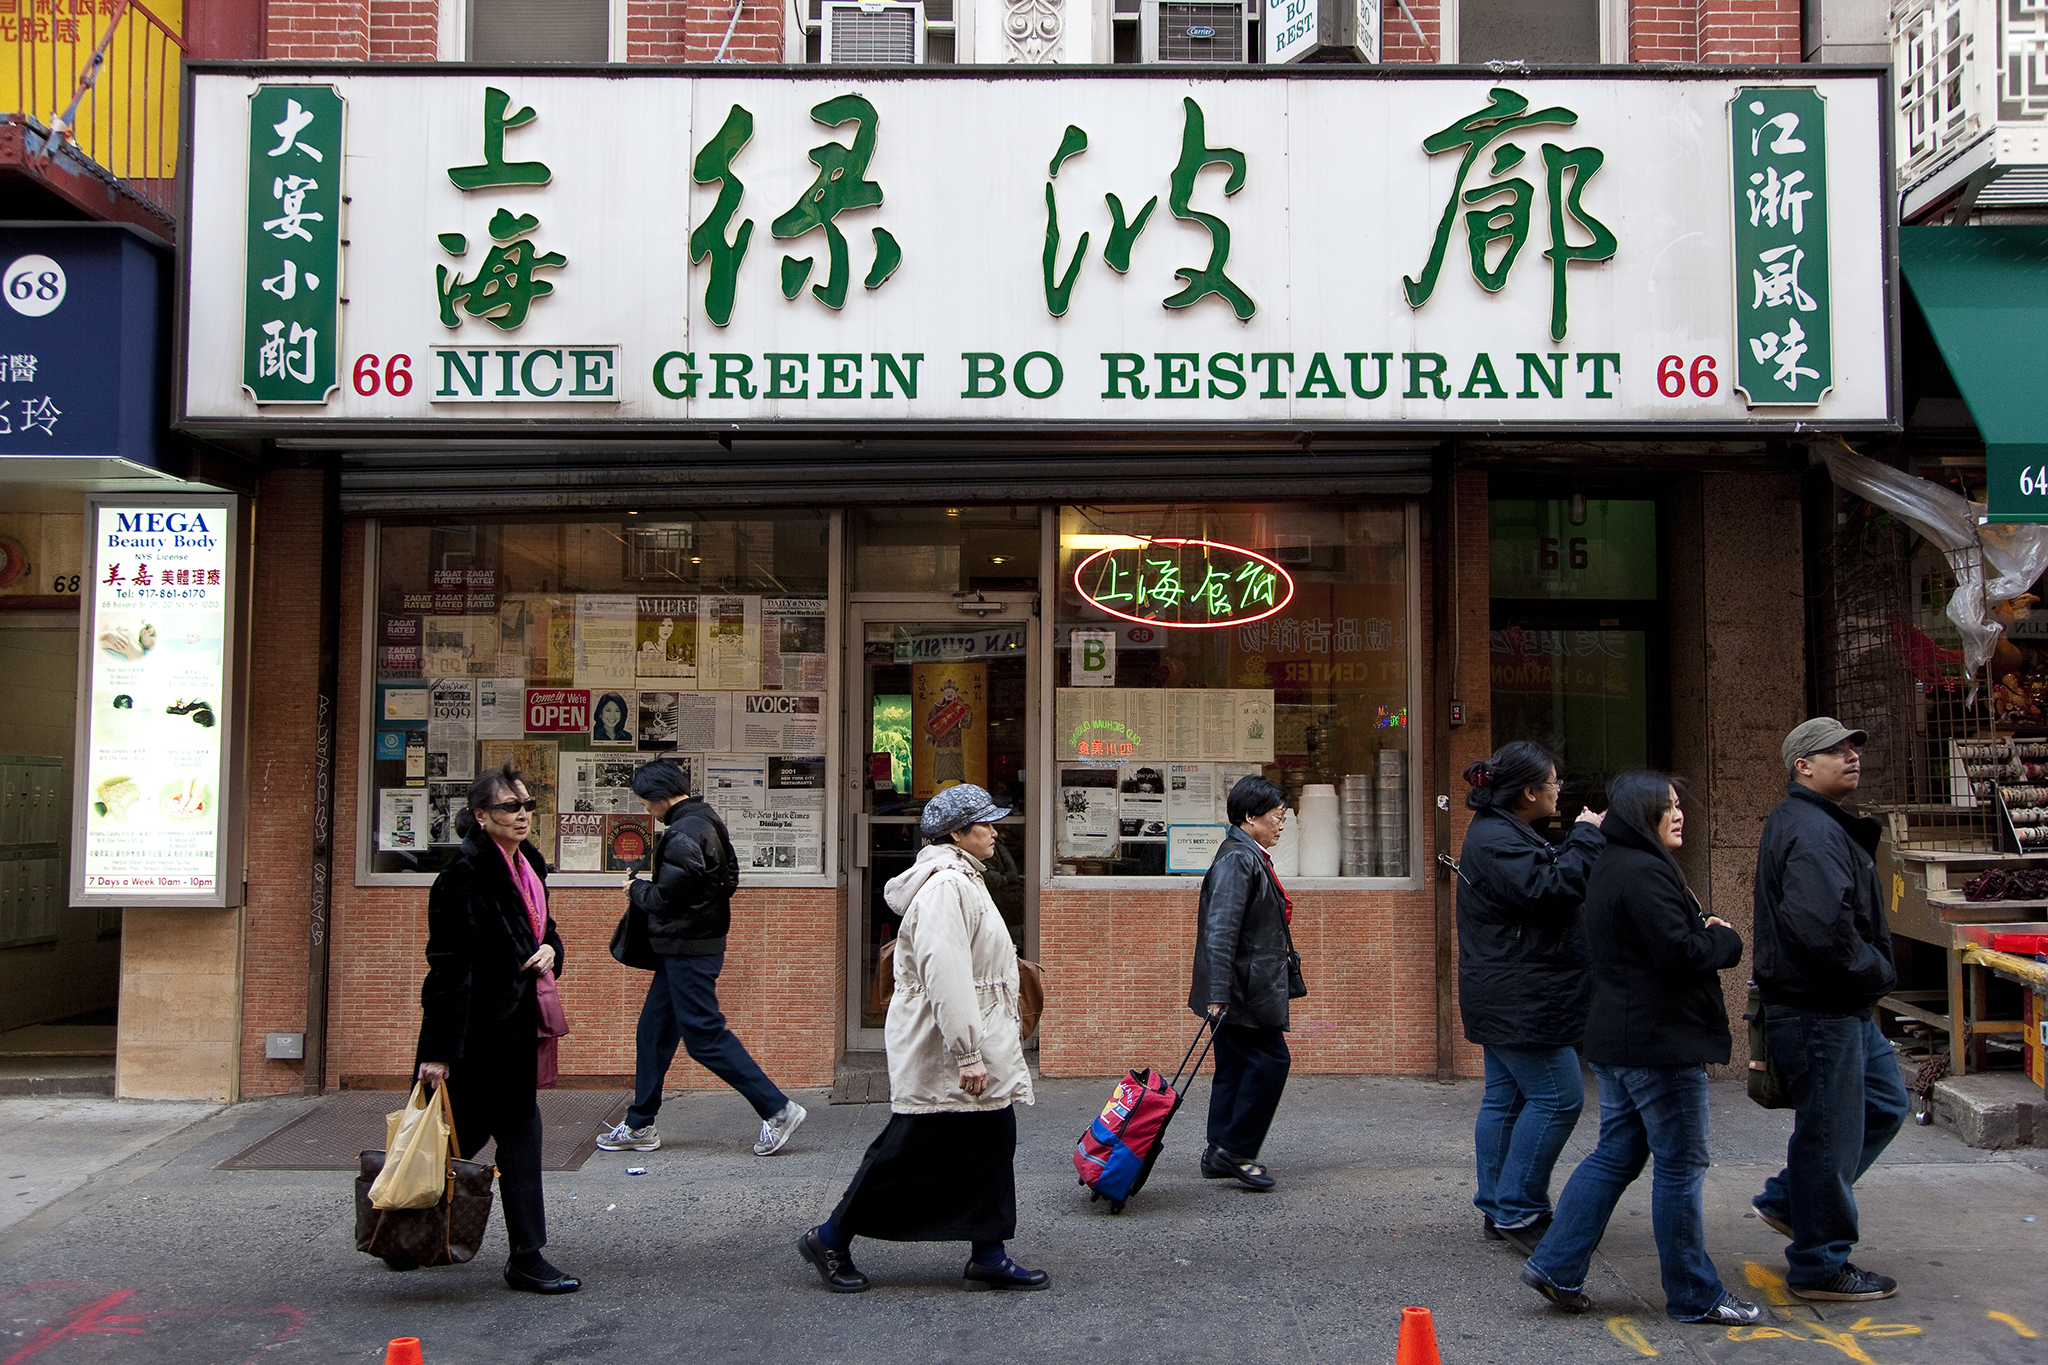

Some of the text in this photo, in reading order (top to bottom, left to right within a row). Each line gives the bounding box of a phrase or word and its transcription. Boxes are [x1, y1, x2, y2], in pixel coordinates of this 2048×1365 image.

[1286, 0, 1307, 23] BO
[1190, 28, 1213, 36] Carrier
[1276, 12, 1315, 53] REST.
[436, 86, 569, 332] 上海
[258, 98, 325, 385] 大宴小酌
[9, 271, 59, 301] 68
[352, 349, 1720, 400] 66 NICE GREEN BO RESTAURANT 66
[116, 512, 210, 533] MEGA
[108, 534, 218, 552] Beauty Body
[134, 553, 189, 561] NYS License
[1540, 537, 1588, 570] 66
[53, 574, 81, 594] 68
[116, 588, 206, 599] Tel: 917-861-6170
[101, 601, 111, 609] 68
[767, 600, 822, 608] DAILY NEWS
[1083, 639, 1106, 671] B
[530, 690, 587, 705] Come in We're
[752, 696, 799, 713] VOICE
[433, 707, 471, 719] 1999
[530, 705, 585, 727] OPEN
[560, 815, 603, 825] ZAGAT
[742, 810, 757, 819] The
[772, 811, 789, 820] York
[789, 811, 810, 819] Times
[560, 825, 603, 834] SURVEY
[759, 820, 783, 828] Dining
[89, 877, 95, 886] 7
[97, 877, 121, 888] Days
[131, 877, 155, 886] Week
[158, 877, 181, 886] 10am
[190, 877, 213, 889] 10pm
